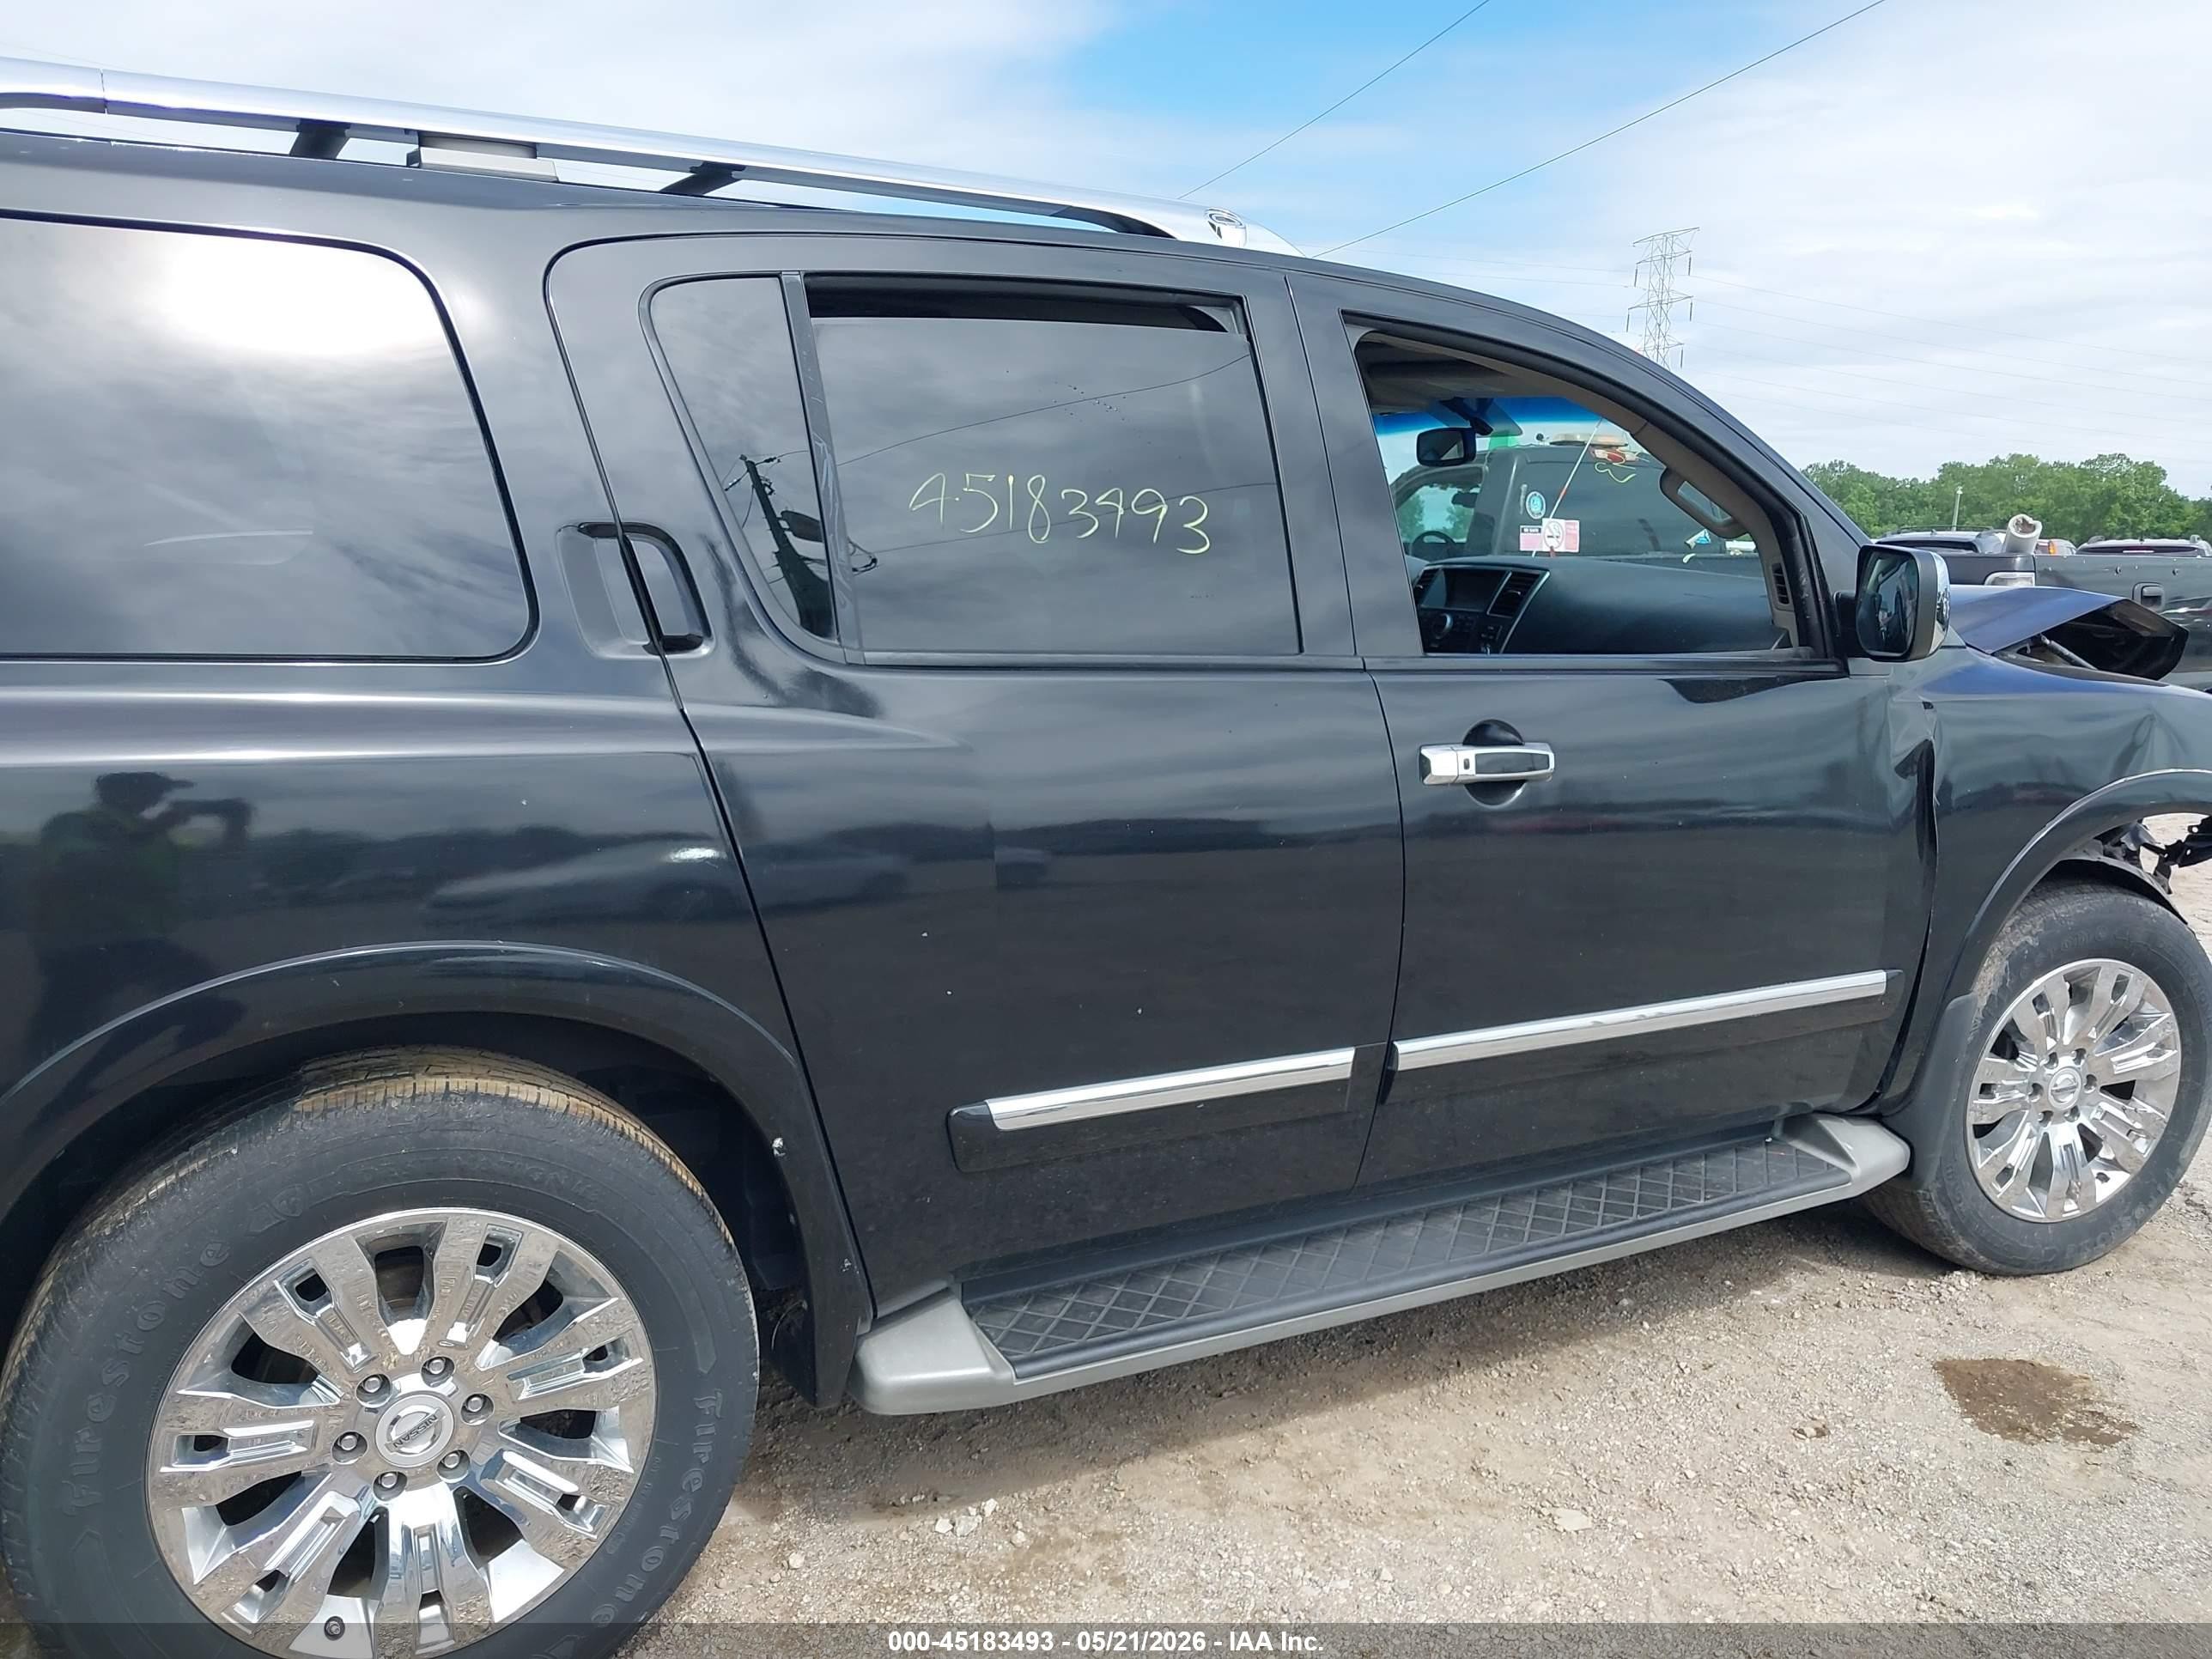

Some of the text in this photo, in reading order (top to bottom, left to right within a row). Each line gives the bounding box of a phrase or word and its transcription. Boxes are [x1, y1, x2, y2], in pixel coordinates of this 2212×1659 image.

[908, 471, 1211, 555] 45183493
[61, 1241, 230, 1517] Firestone
[392, 1413, 439, 1449] NISSAN
[591, 1388, 724, 1628] Firestone
